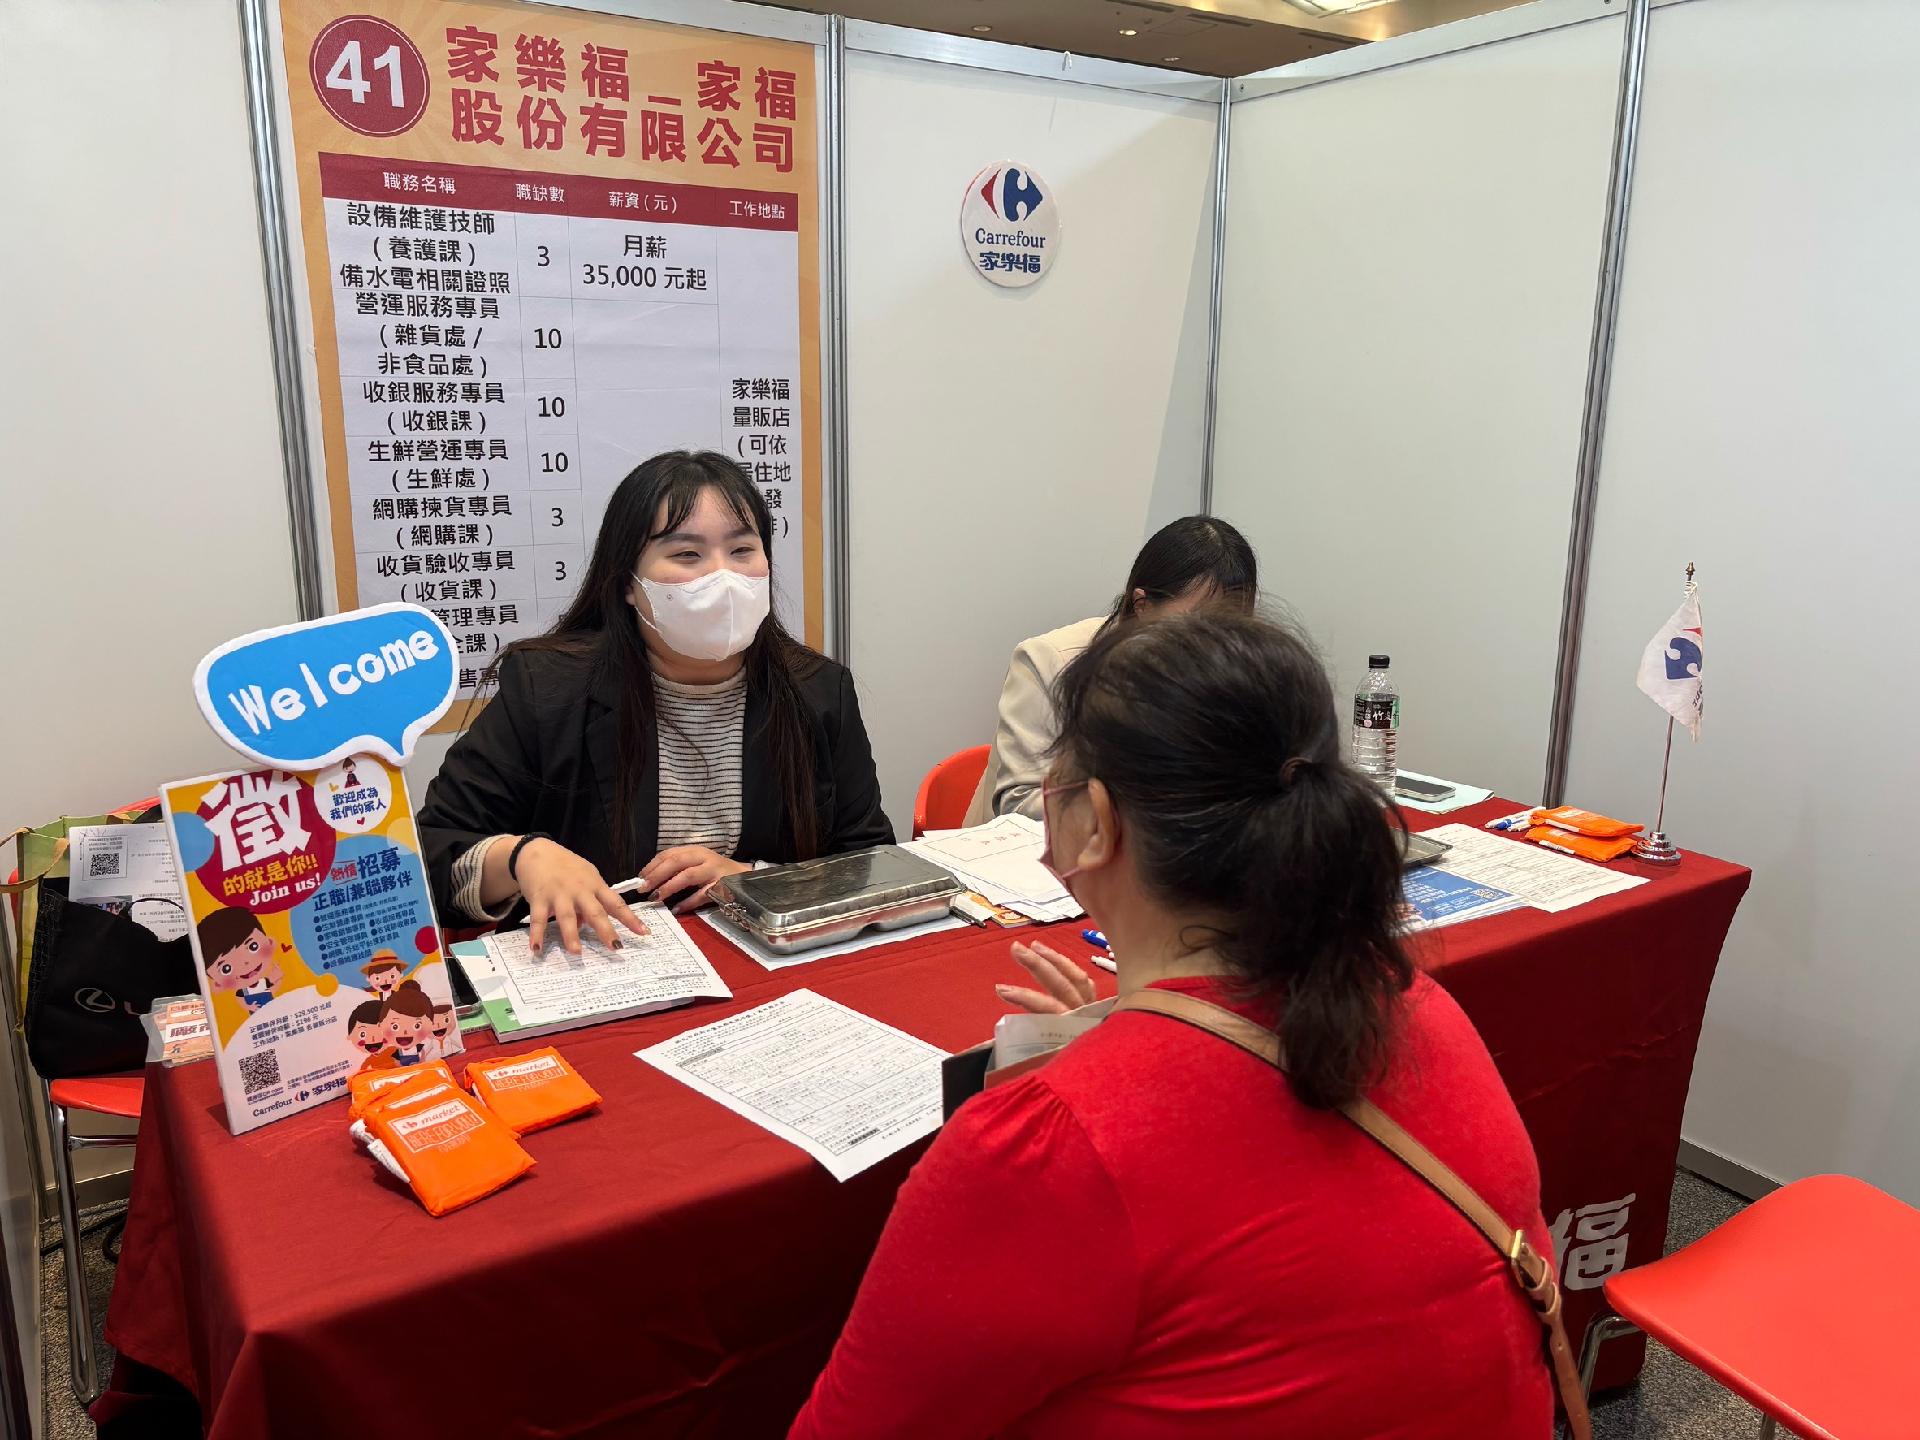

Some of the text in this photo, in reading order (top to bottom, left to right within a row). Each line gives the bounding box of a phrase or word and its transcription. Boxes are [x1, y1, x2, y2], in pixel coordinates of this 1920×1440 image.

[325, 40, 406, 108] 41
[451, 88, 795, 173] 股份有限公司
[383, 172, 456, 196] 職務名稱
[515, 183, 565, 203] 職缺數
[347, 202, 495, 235] 設備維護技師
[729, 200, 785, 220] 工作地點
[623, 234, 667, 259] 月薪
[975, 227, 1046, 248] Carrefour
[537, 245, 550, 267] 3
[980, 251, 1041, 274] 家樂福
[340, 263, 511, 294] 備水電相關證照
[583, 263, 707, 291] 35,000 元起
[356, 292, 500, 319] 營運服務專員
[534, 328, 562, 349] 10
[363, 381, 505, 404] 收銀服務專員
[732, 377, 790, 401] 家樂福
[538, 396, 565, 418] 10
[733, 406, 790, 427] 量販店
[368, 439, 509, 462] 生鮮營運專員
[541, 452, 569, 473] 10
[372, 495, 513, 521] 網購揀貨專員
[551, 507, 564, 527] 3
[377, 550, 515, 577] 收貨驗收專員
[555, 561, 567, 581] 3
[227, 630, 440, 735] Welcome
[330, 797, 387, 821] 我們的家人
[357, 846, 401, 878] 招募
[250, 872, 321, 906] Join us!
[252, 1097, 293, 1117] Carrefour
[421, 1104, 460, 1125] market
